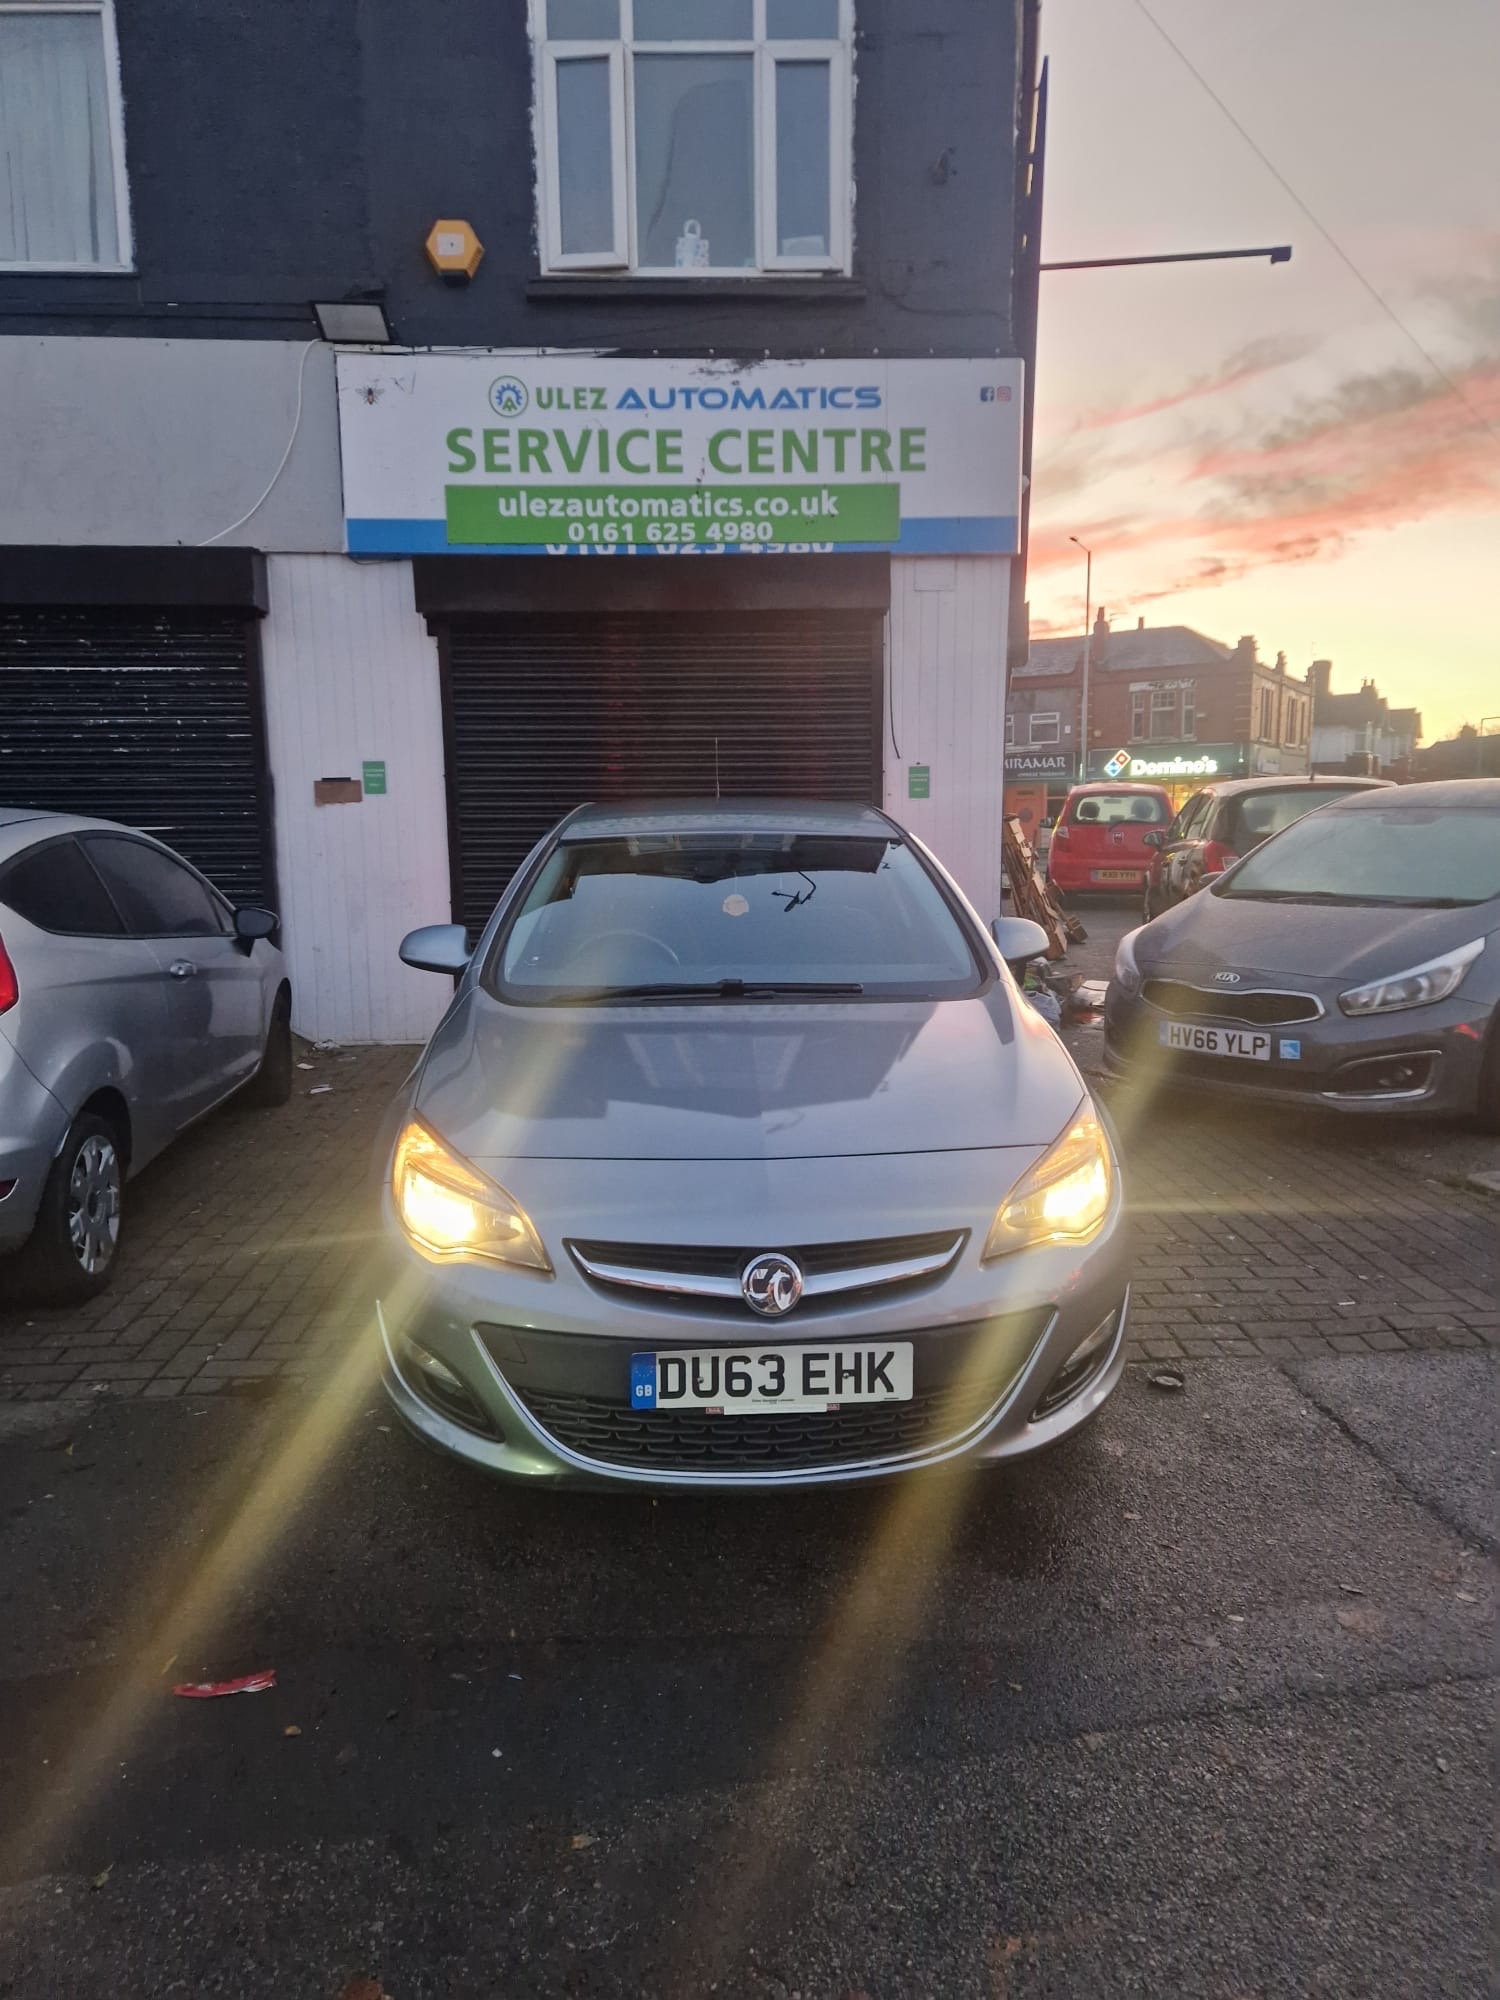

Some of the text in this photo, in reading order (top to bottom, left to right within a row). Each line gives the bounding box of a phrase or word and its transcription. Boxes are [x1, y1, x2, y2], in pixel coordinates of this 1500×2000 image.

[535, 385, 882, 410] ULEZ AUTOMATICS
[445, 427, 926, 474] SERVICE CENTRE
[498, 490, 839, 518] ulezautomatics.co.uk
[567, 521, 773, 542] 0161 625 4980
[1131, 755, 1218, 776] Domino's
[1215, 972, 1235, 982] KIA
[1170, 1025, 1266, 1056] HV66 YLP
[658, 1351, 895, 1400] DU63 EHK
[635, 1384, 653, 1397] GB
